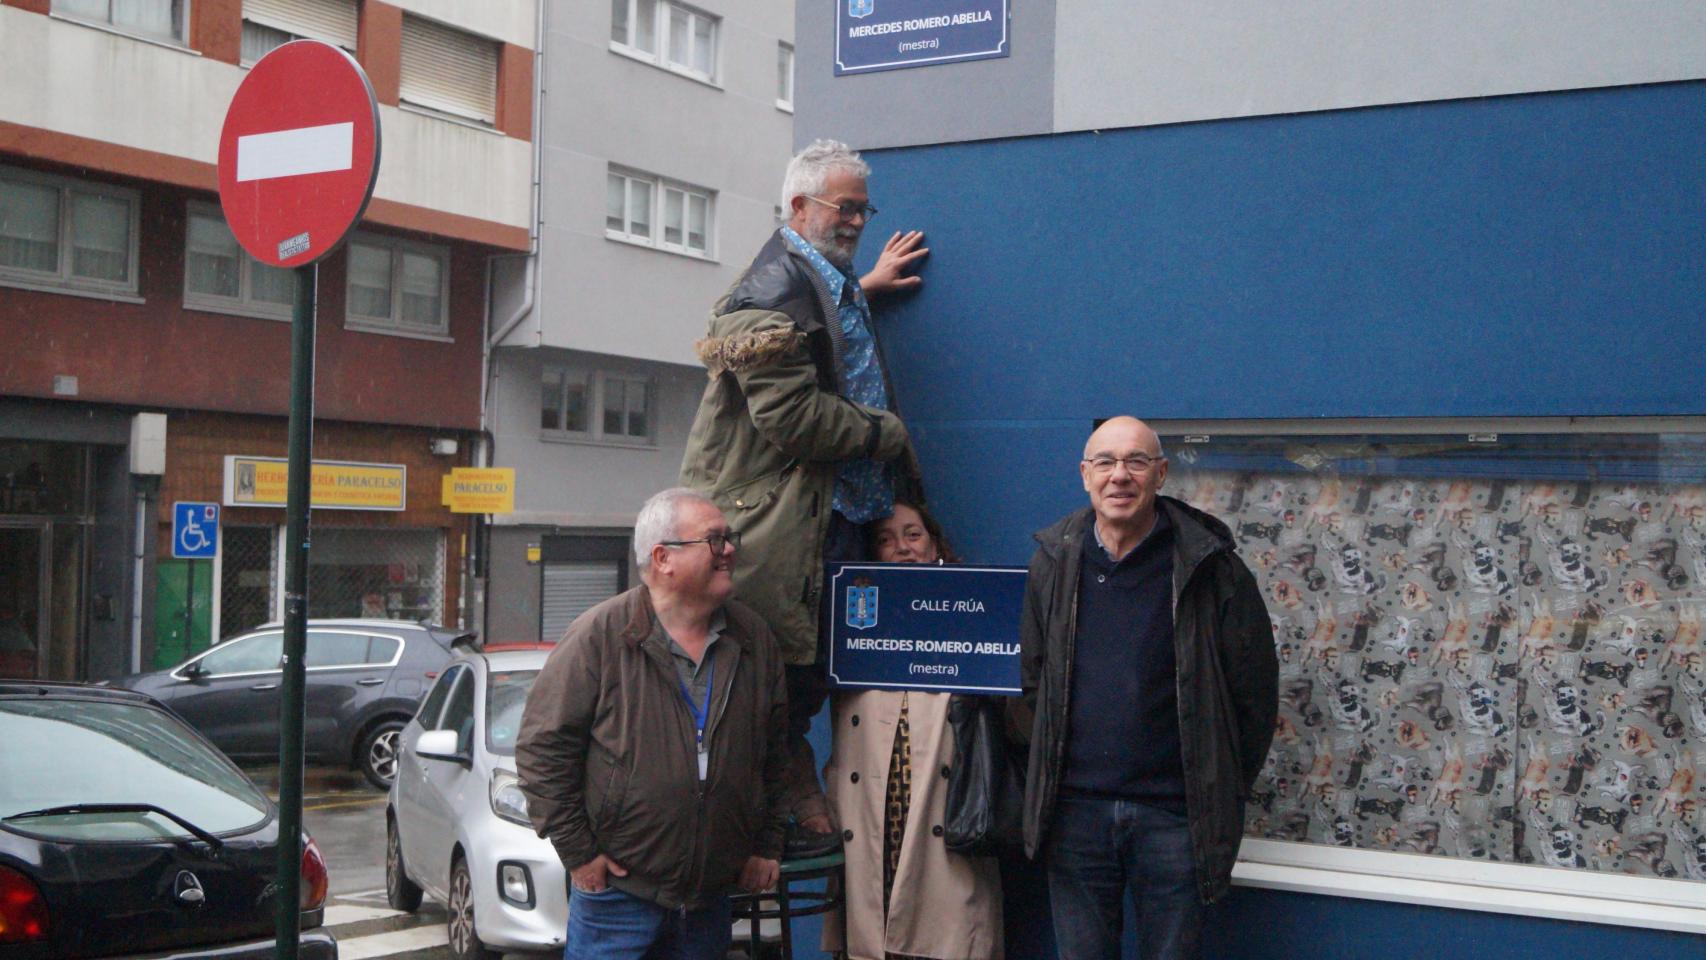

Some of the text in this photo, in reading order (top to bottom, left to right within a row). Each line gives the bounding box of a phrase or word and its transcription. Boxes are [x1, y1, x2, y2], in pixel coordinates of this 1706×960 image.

[849, 10, 992, 38] MERCEDES ROMERO ABELLA
[899, 38, 939, 53] (mestra)
[337, 475, 401, 488] PARACELSO
[911, 598, 985, 613] CALLE /RÚA
[847, 638, 1021, 655] MERCEDES ROMERO ABELLA
[909, 663, 959, 676] (mestra)
